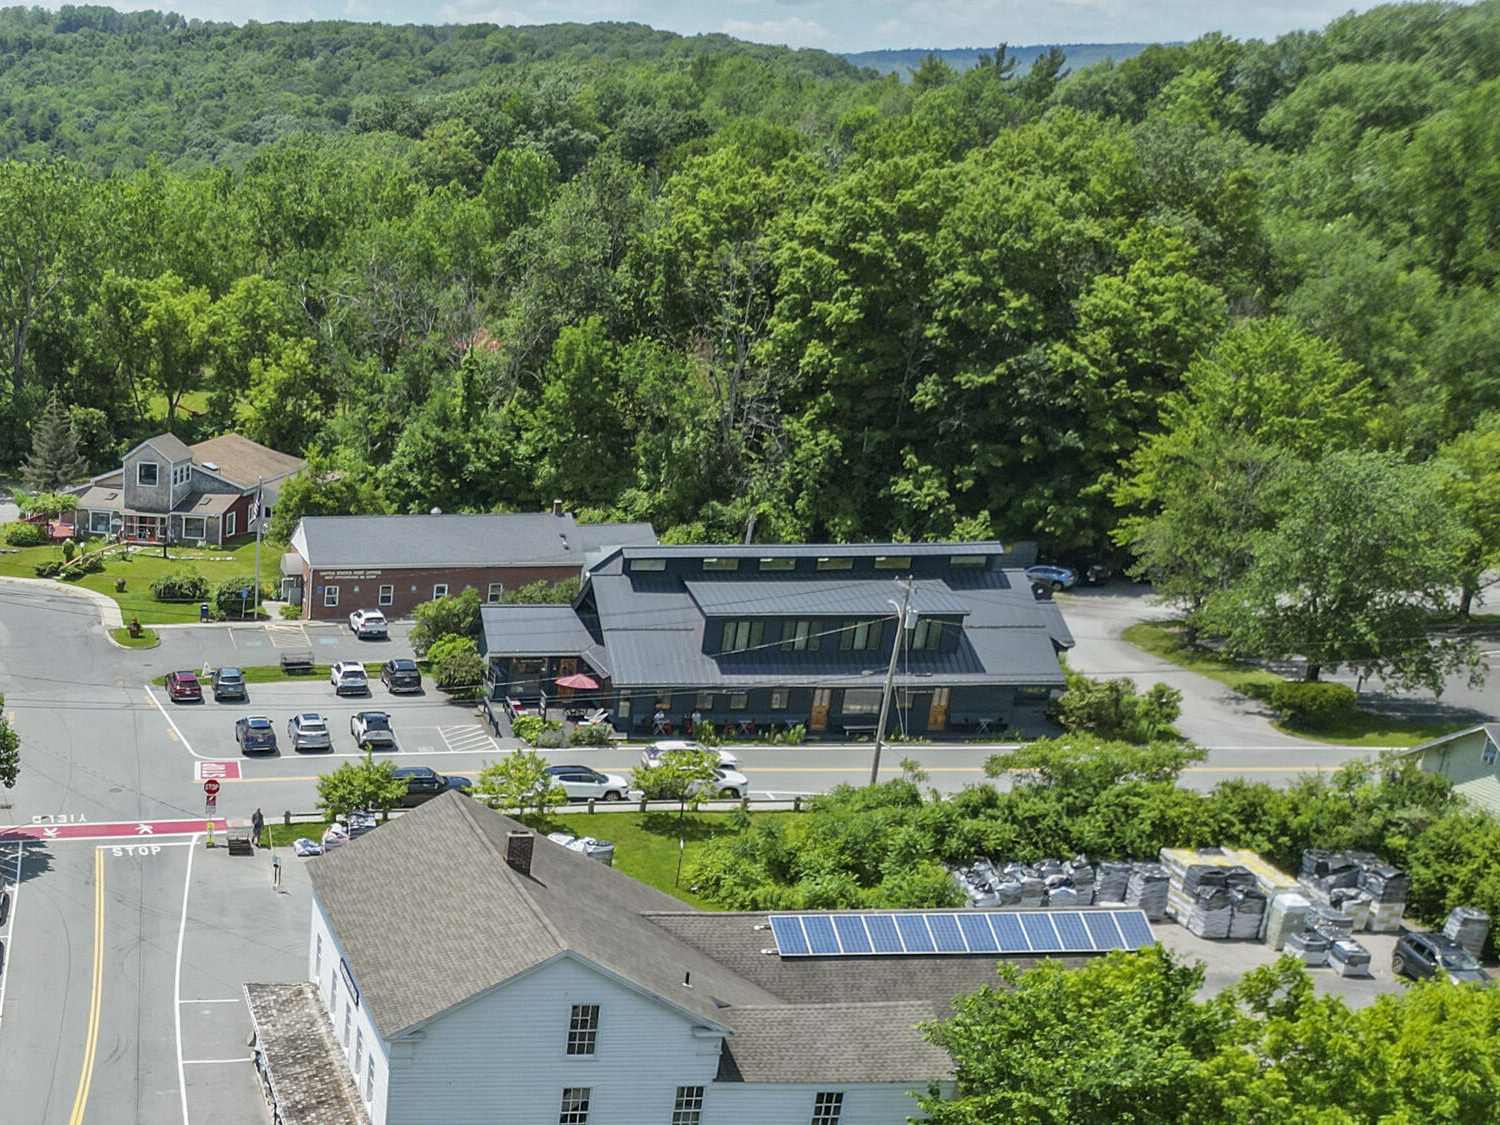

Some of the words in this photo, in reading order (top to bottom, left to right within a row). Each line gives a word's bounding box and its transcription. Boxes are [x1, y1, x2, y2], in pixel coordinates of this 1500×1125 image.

[202, 763, 226, 778] STOP
[32, 813, 88, 824] YIELD
[112, 846, 161, 857] STOP
